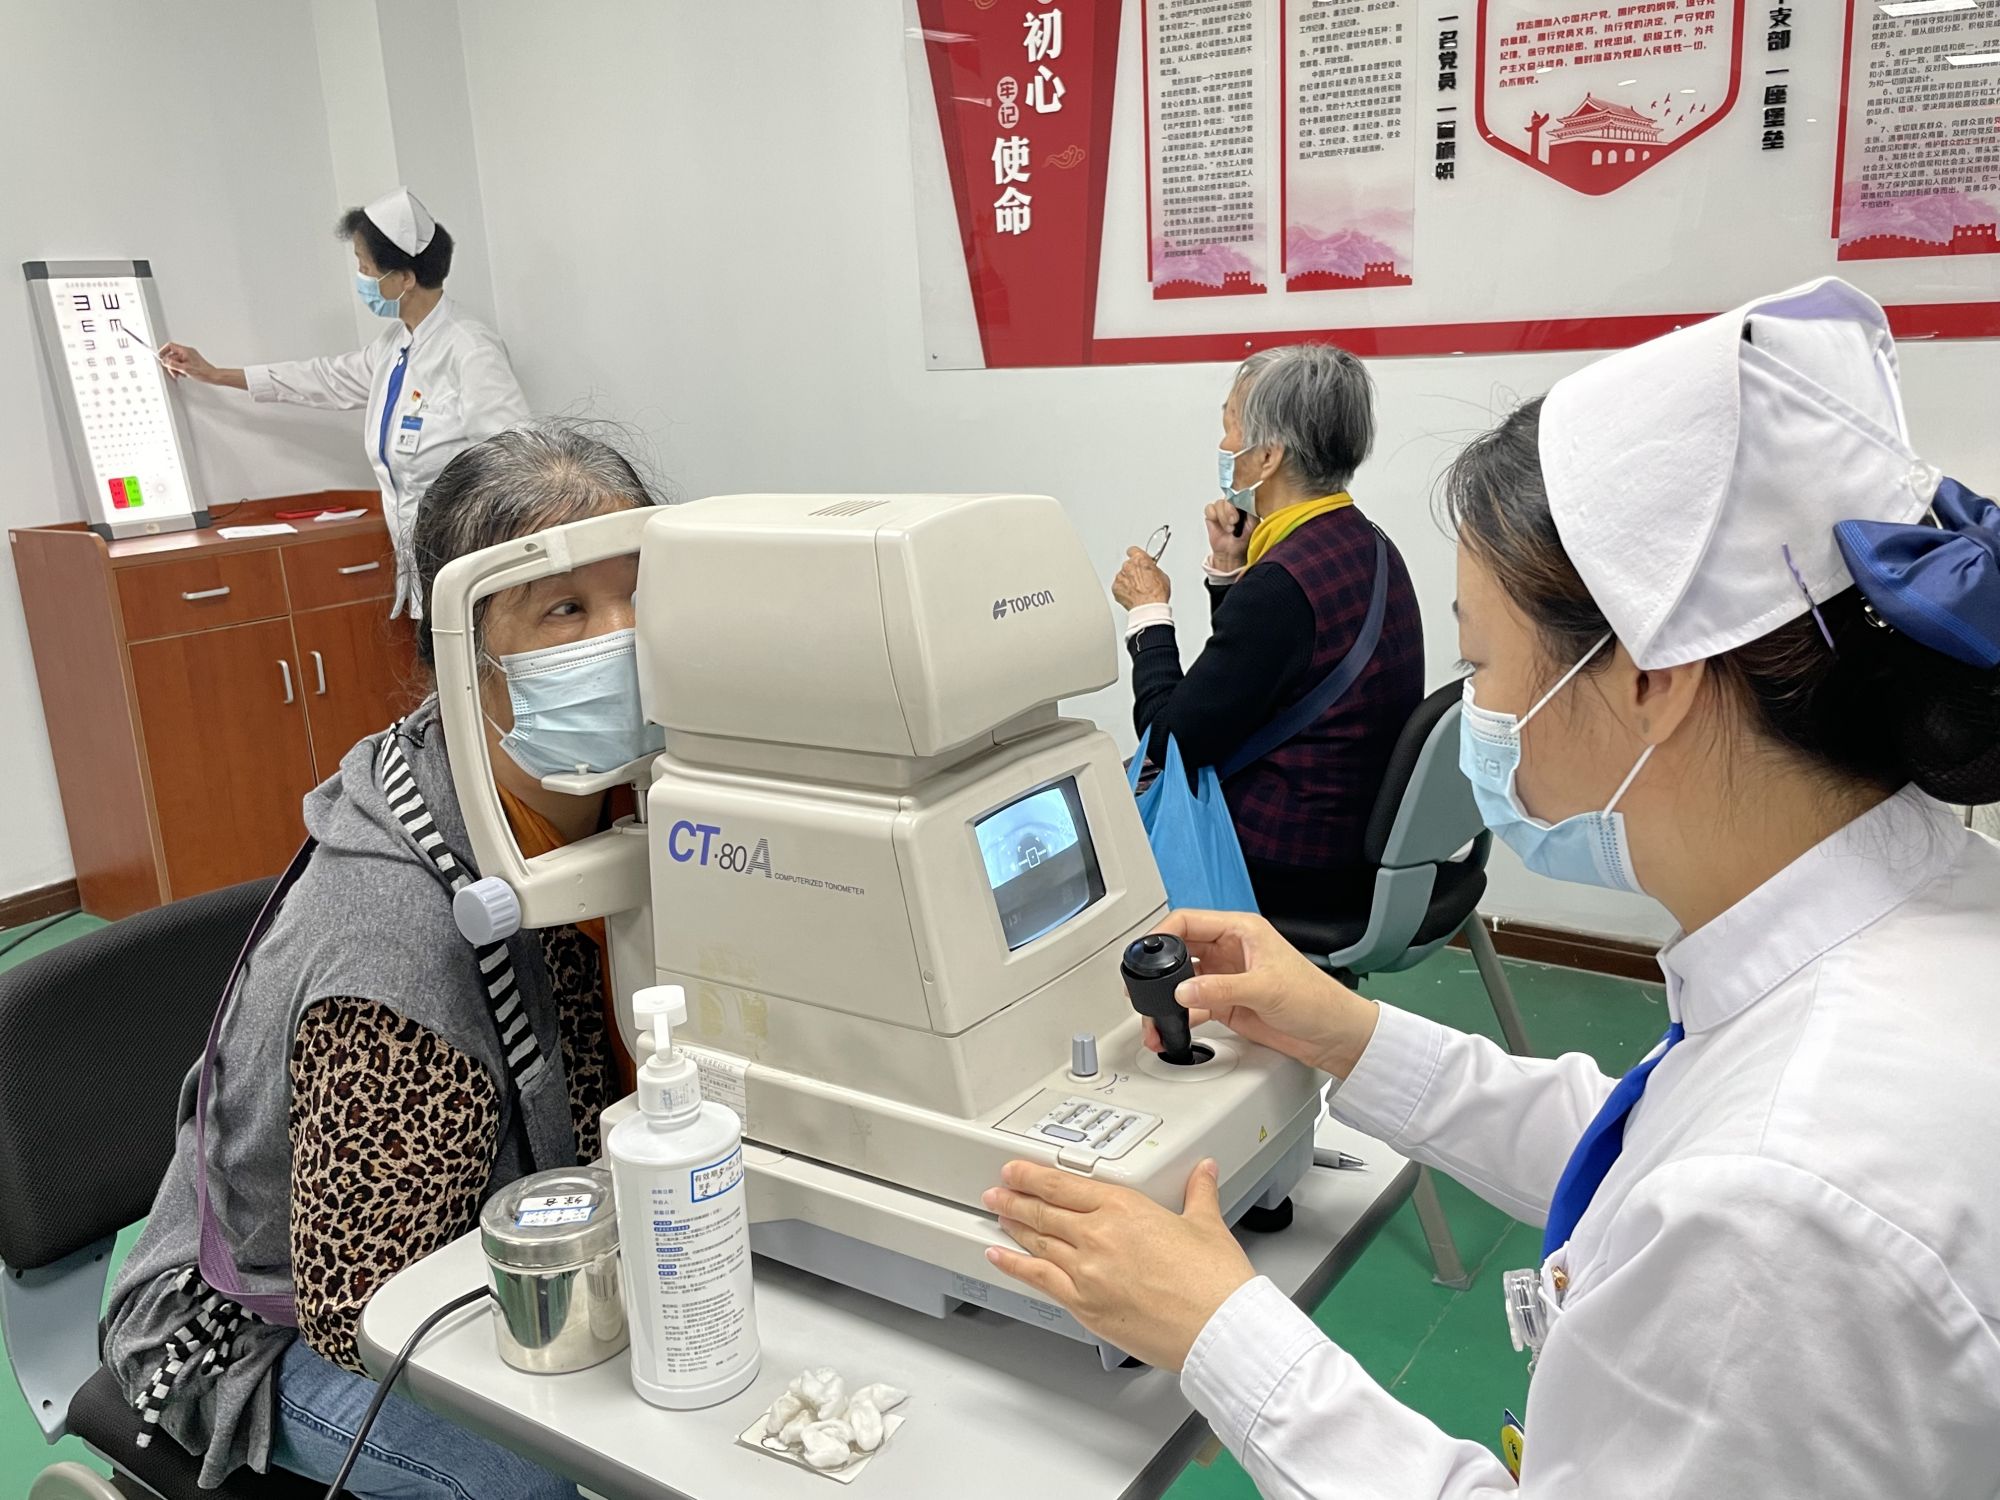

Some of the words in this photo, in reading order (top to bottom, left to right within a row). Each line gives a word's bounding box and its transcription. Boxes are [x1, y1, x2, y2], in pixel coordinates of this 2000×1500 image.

[1768, 0, 1792, 51] 支部
[1023, 8, 1066, 113] 初心
[1438, 16, 1458, 91] 一名党员
[1000, 82, 1016, 124] 牢记
[1499, 76, 1539, 88] 永不叛党。
[1762, 69, 1789, 150] 一座堡垒
[992, 136, 1032, 235] 使命
[1008, 590, 1055, 613] TOPCON
[774, 872, 823, 888] COMPUTERIZED
[824, 881, 865, 895] TONOMETER
